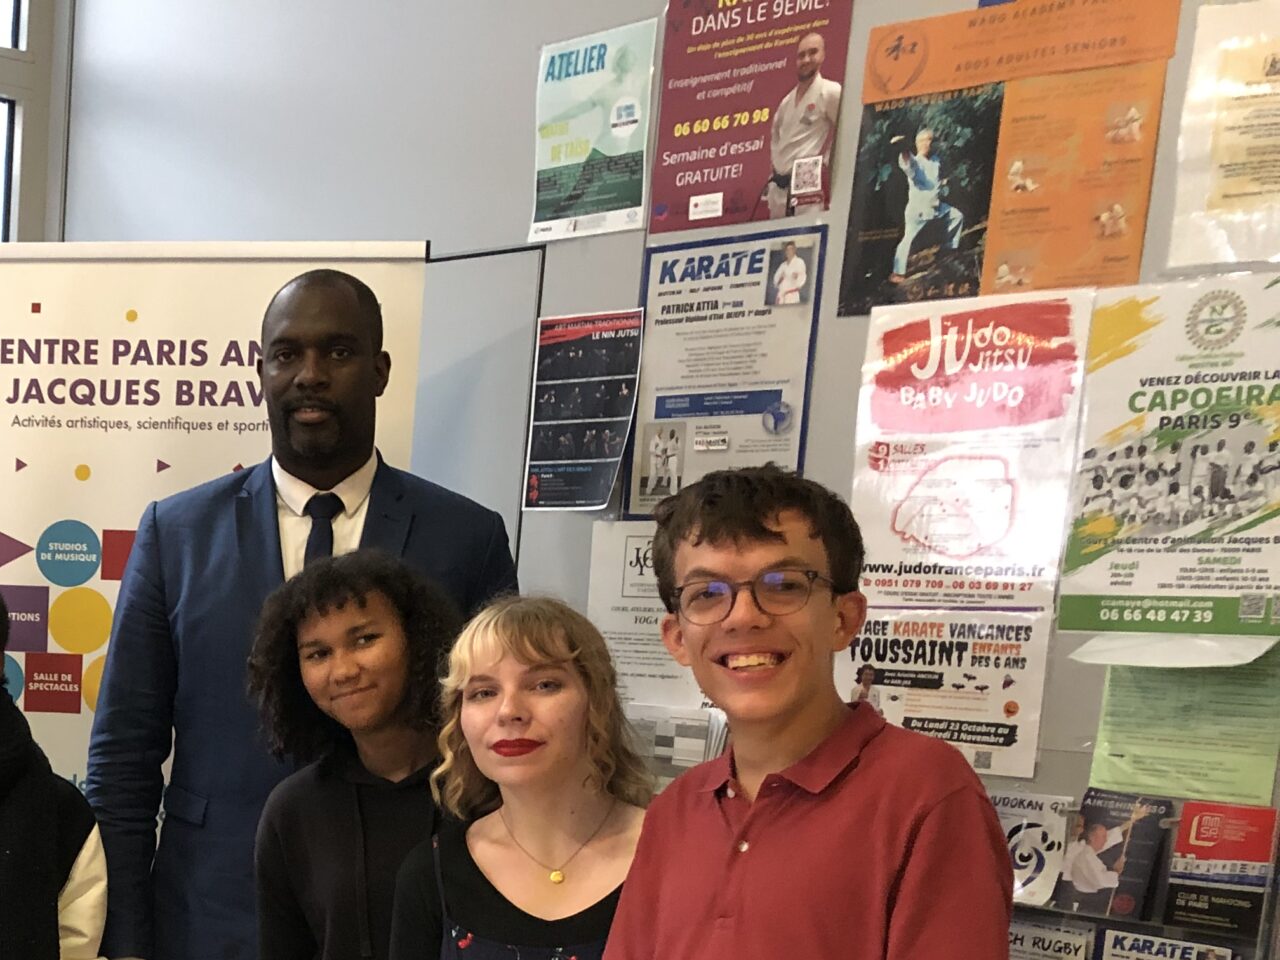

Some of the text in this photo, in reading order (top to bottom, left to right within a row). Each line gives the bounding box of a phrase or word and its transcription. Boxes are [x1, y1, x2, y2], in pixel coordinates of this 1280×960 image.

[692, 8, 741, 35] DANS
[746, 2, 768, 24] LE
[545, 43, 607, 82] ATELIER
[668, 58, 787, 89] Enseignement traditionnel
[696, 80, 755, 100] et compétitif
[674, 108, 770, 137] 06 60 66 70 98
[662, 136, 765, 166] Semaine d'essai
[675, 163, 743, 187] GRATUITE!
[659, 248, 766, 285] KARATE
[661, 301, 695, 315] PATRICK
[696, 300, 719, 312] ATTIA
[592, 329, 639, 340] LE NIN JUTSU
[112, 339, 208, 366] PARIS
[220, 340, 263, 367] AN
[1140, 375, 1182, 388] VENEZ
[1184, 371, 1261, 385] DÉCOUVRIR
[5, 378, 265, 407] JACQUES BRAV
[900, 381, 1024, 410] BABY JUDO
[1128, 383, 1280, 413] CAPOEIRA
[11, 414, 270, 434] Activités artistiques, scientifiques et sporti
[1159, 413, 1221, 430] PARIS
[48, 542, 88, 551] STUDIOS
[1125, 536, 1159, 544] Centre
[1226, 536, 1271, 546] Jacques
[41, 553, 97, 562] DE MUSIQUE
[1197, 556, 1242, 565] SAMEDI
[875, 579, 898, 587] 0951
[902, 579, 921, 588] 079
[952, 581, 965, 589] 06
[969, 581, 981, 590] 03
[1002, 582, 1015, 590] 91
[1019, 582, 1034, 591] 27
[8, 612, 41, 622] TIONS
[635, 616, 658, 624] YOGA
[1100, 609, 1213, 622] 06 66 48 47 39
[859, 620, 1033, 642] AGE KARATE VANCANCES
[849, 637, 1022, 667] TOUSSAINT ENFANTS
[970, 656, 1027, 670] DES 6 ANS
[33, 673, 72, 682] SALLE DE
[28, 682, 80, 692] SPECTACLES
[911, 719, 922, 727] Du
[924, 720, 948, 729] Lundi
[949, 722, 960, 730] 23
[961, 723, 996, 734] Octobre
[914, 729, 951, 739] dredi
[960, 732, 1004, 744] Novembre
[1032, 936, 1082, 957] RUGBY
